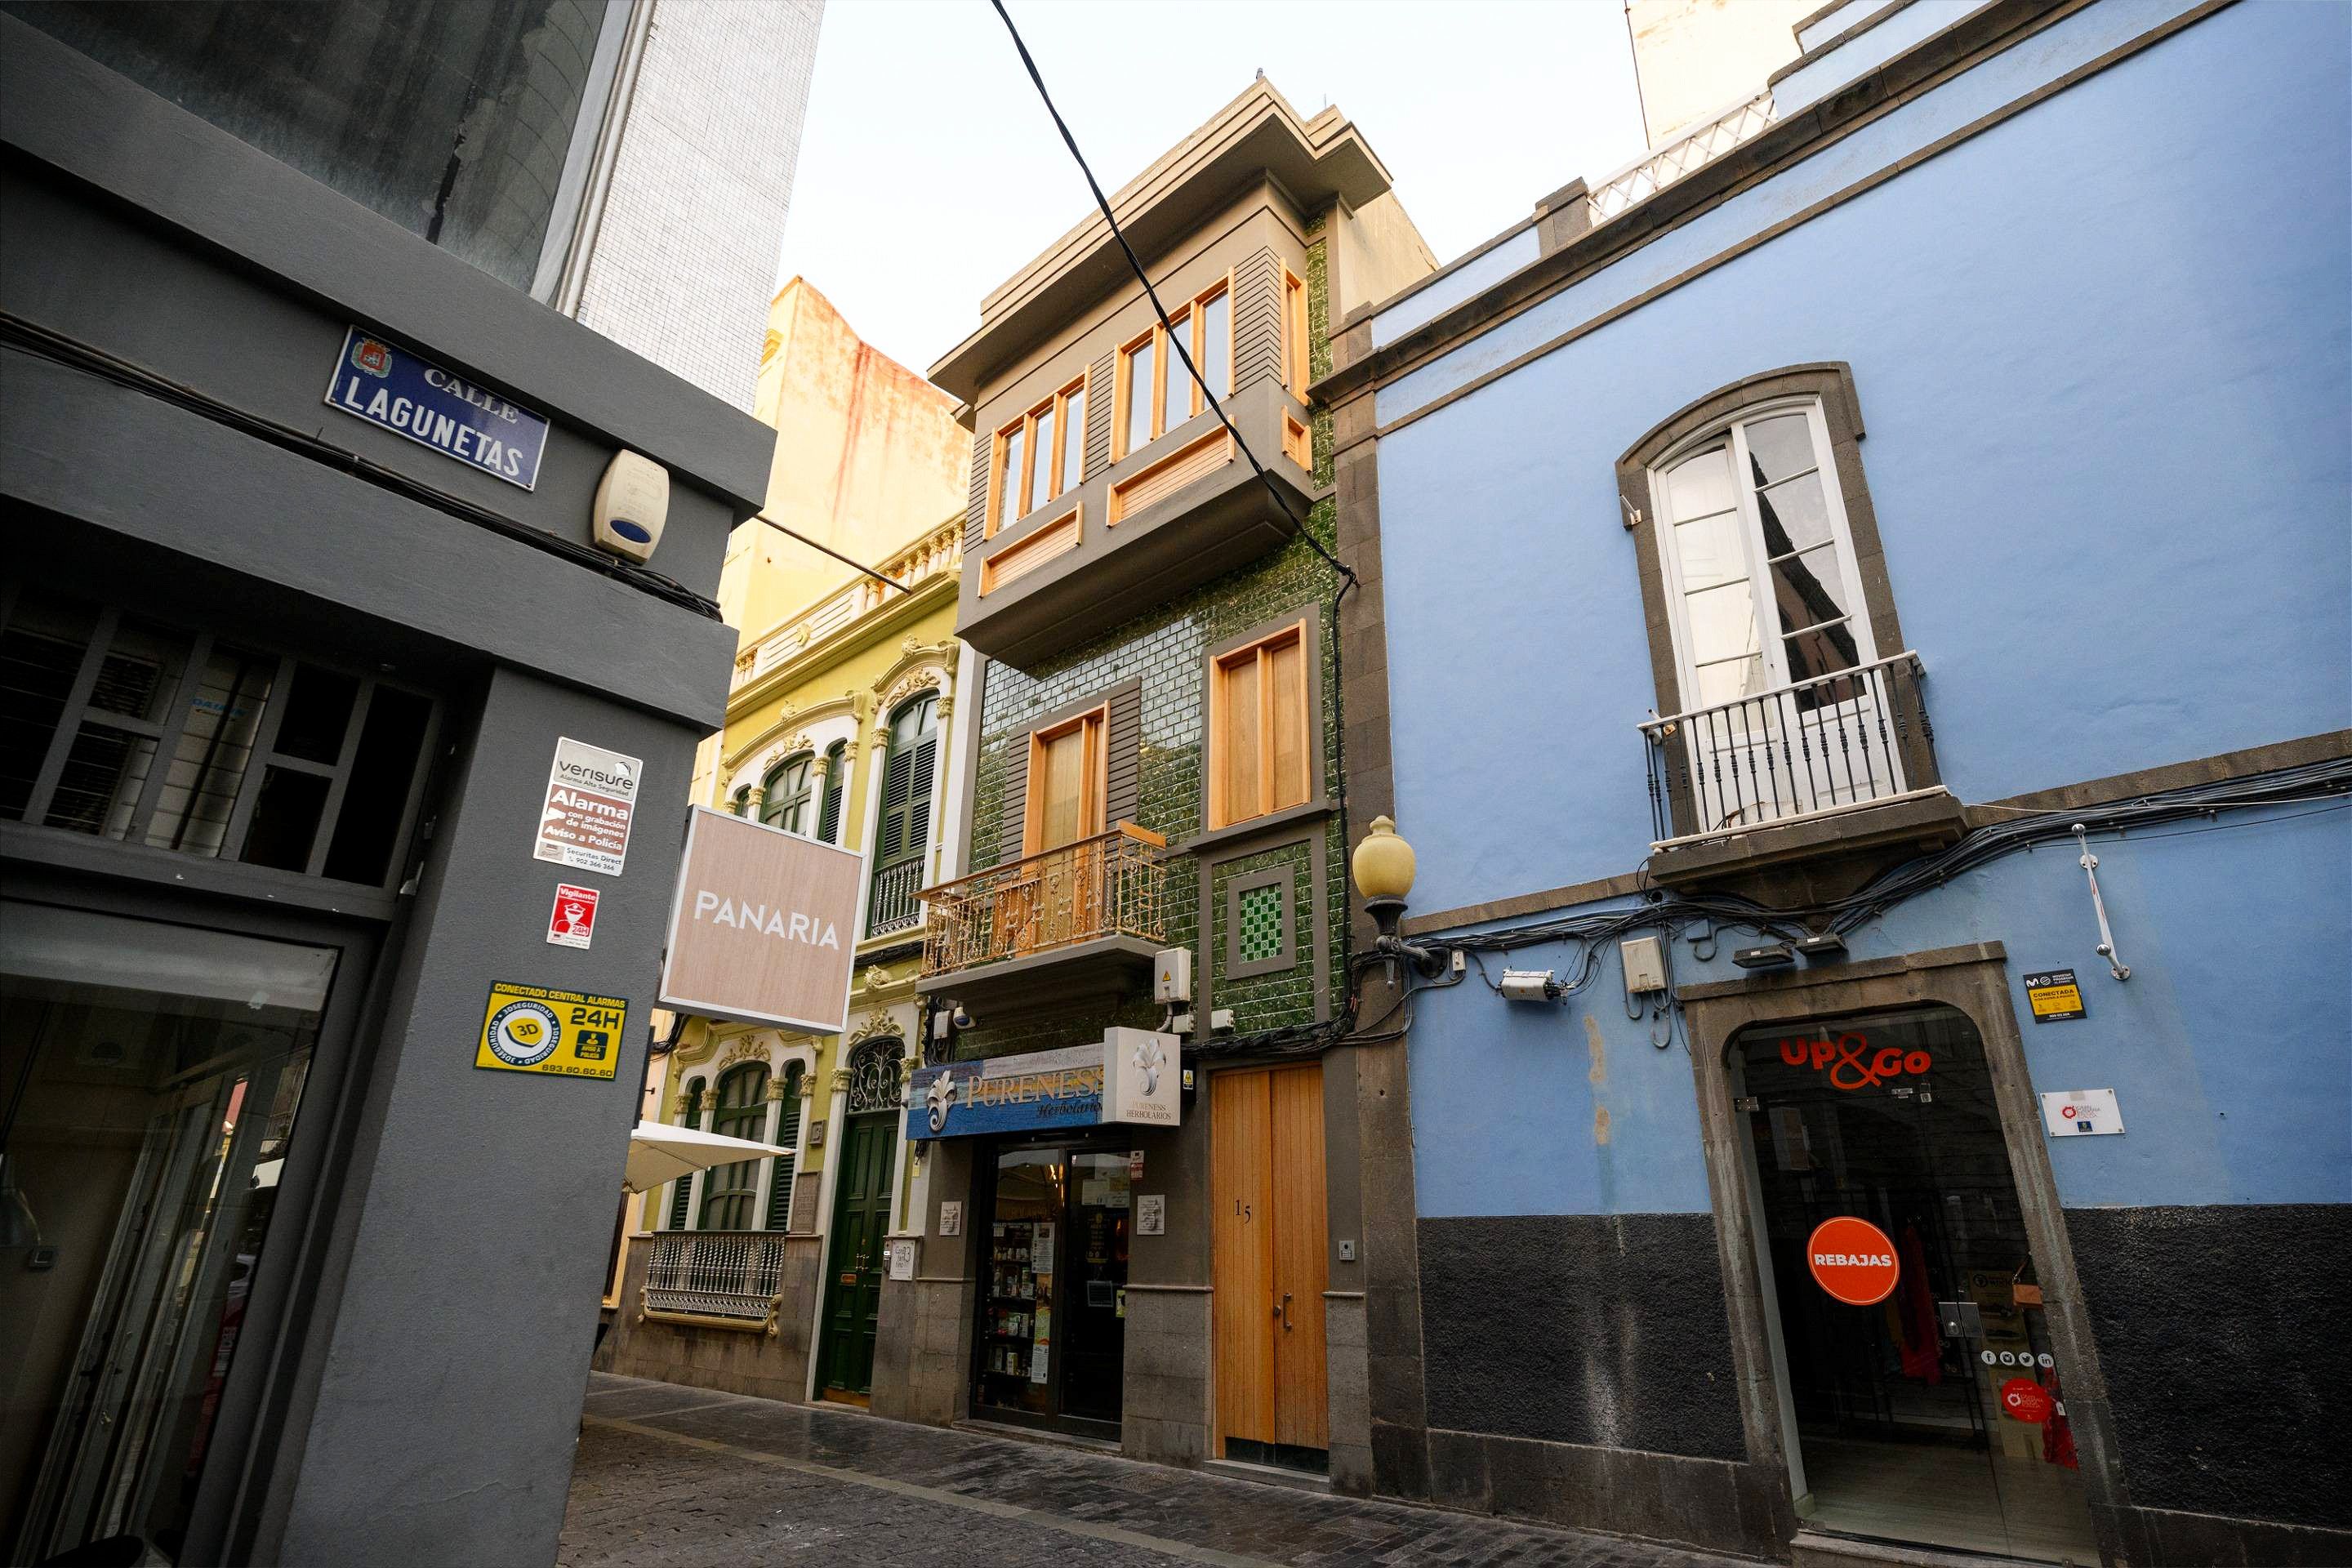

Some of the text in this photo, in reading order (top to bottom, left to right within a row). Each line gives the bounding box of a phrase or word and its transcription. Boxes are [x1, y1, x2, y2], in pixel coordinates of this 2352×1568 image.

[424, 368, 519, 425] CALLE
[344, 376, 523, 477] LAGUNETAS
[559, 760, 634, 790] verisure
[550, 789, 629, 821] Alarma
[566, 818, 625, 838] de imágenes
[585, 815, 626, 830] grabación
[544, 826, 576, 840] Aviso
[588, 835, 622, 850] Policía
[559, 887, 596, 901] Vigilante
[694, 889, 840, 951] PANARIA
[494, 983, 626, 1009] CONECTADO CENTRAL ALARMAS
[2033, 989, 2074, 998] CONECTADA
[516, 1023, 540, 1036] 3D
[570, 1007, 621, 1030] 24H
[1234, 1200, 1251, 1224] 15
[1814, 1253, 1893, 1268] REBAJAS
